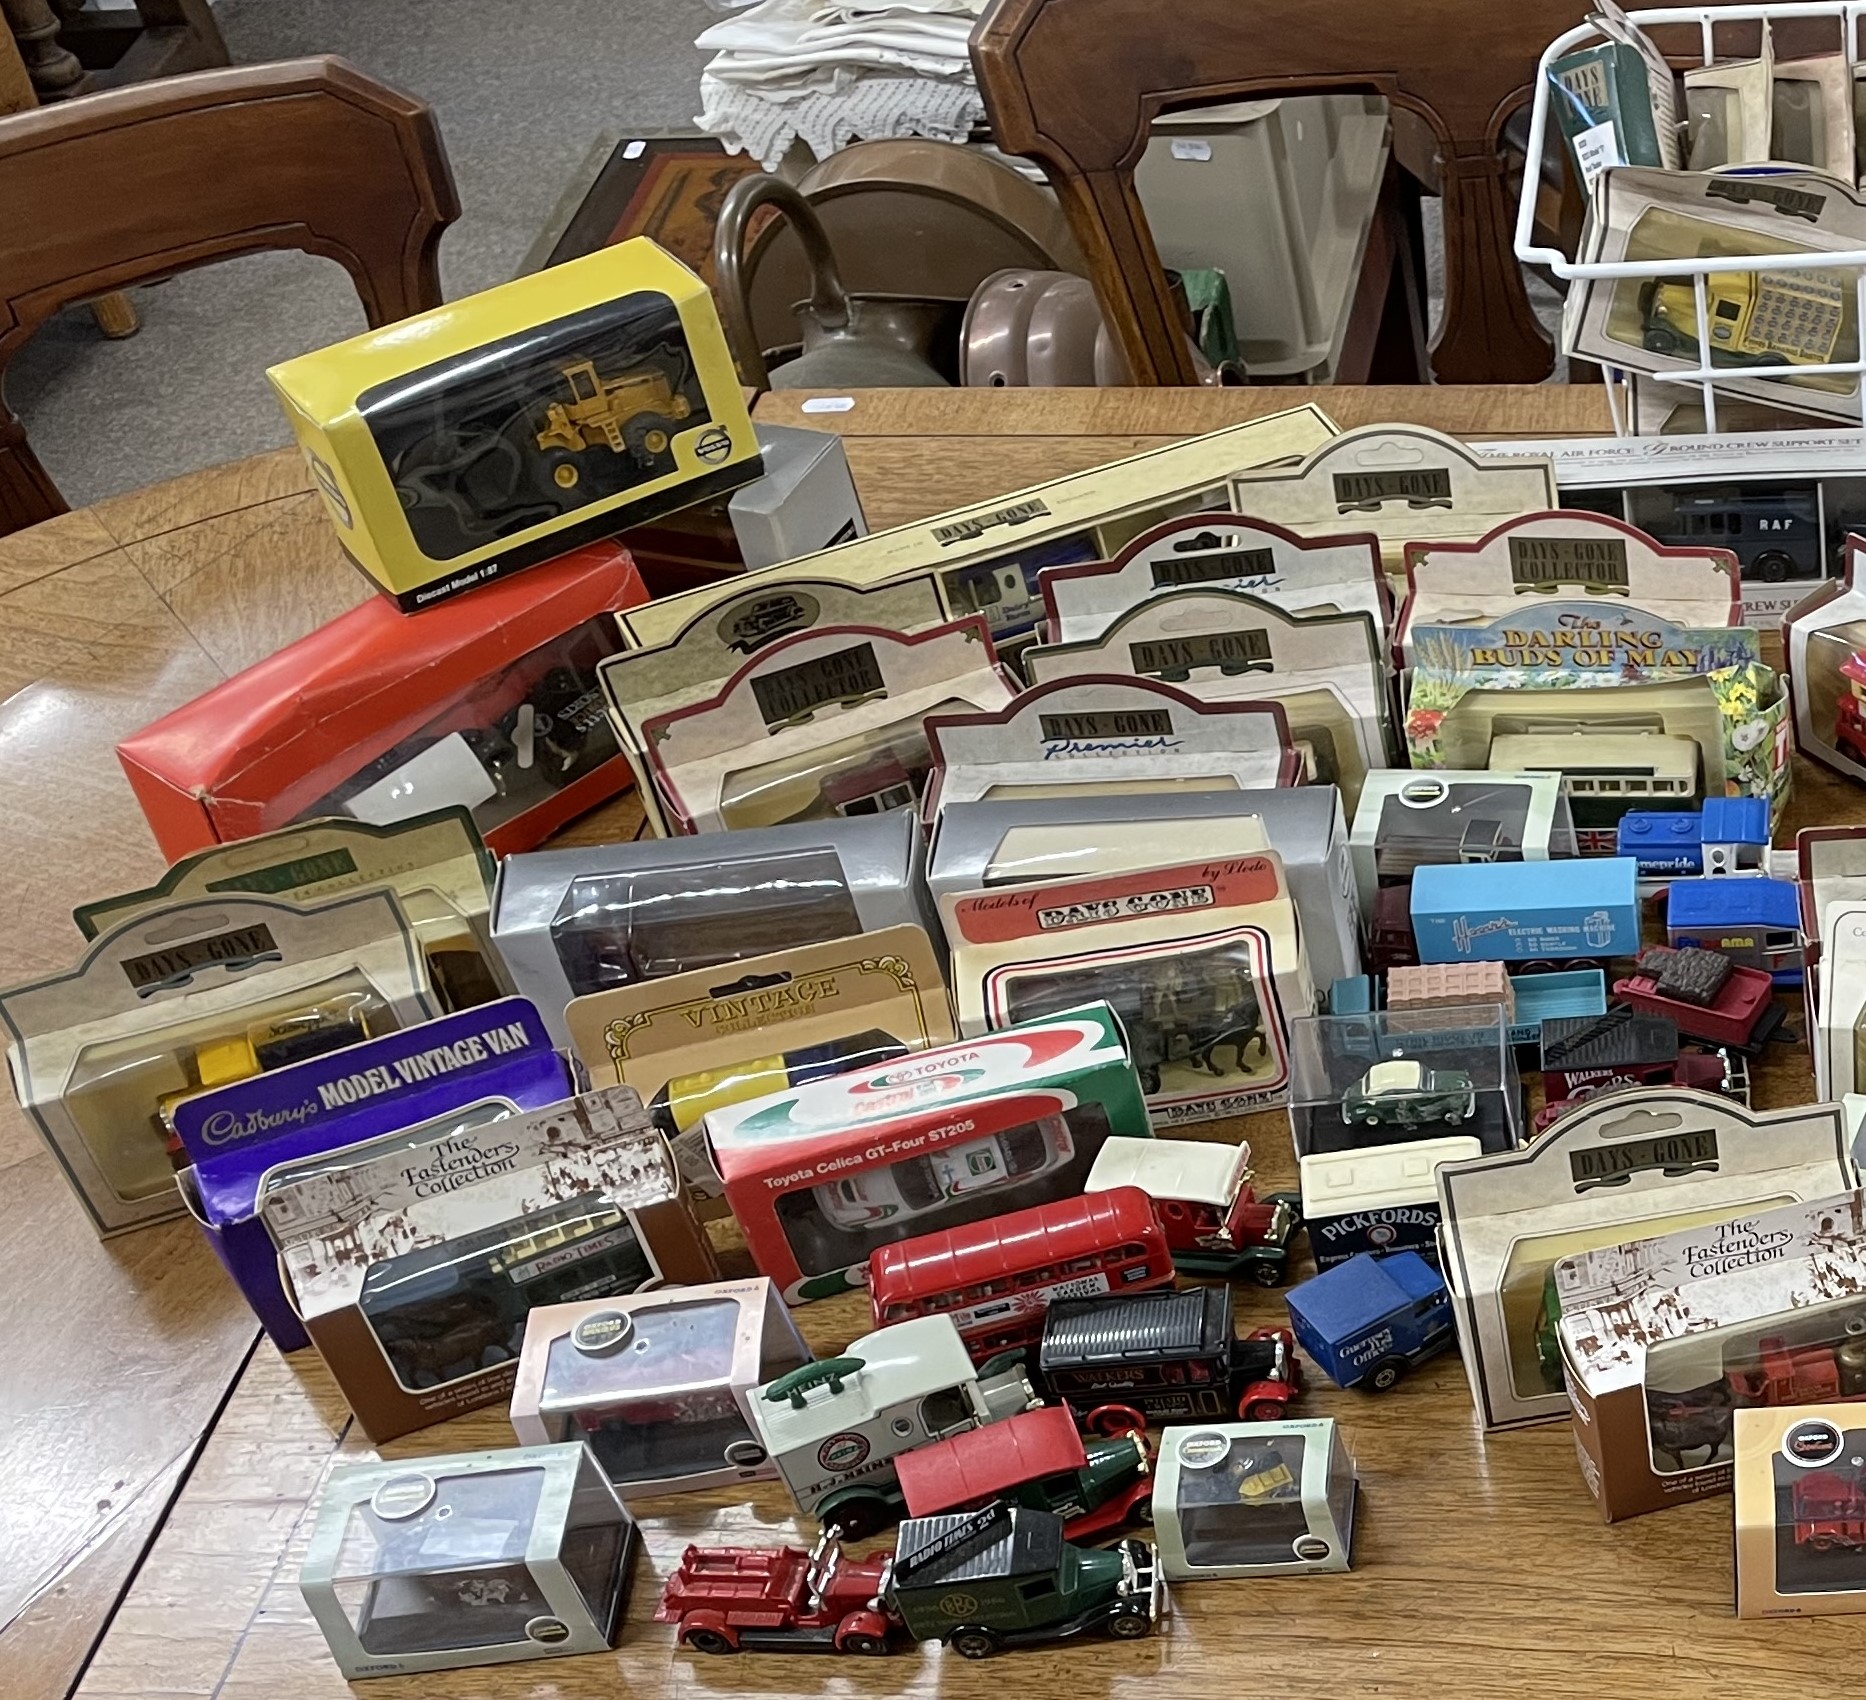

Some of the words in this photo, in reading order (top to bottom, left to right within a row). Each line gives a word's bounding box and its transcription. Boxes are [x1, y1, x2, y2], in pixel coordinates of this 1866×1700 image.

[1588, 446, 1634, 456] FORCE
[1725, 440, 1770, 451] CREW
[1759, 518, 1793, 531] RAF
[1503, 629, 1664, 650] DARLING
[1471, 647, 1564, 668] BUDS
[1571, 647, 1617, 667] OF
[1623, 648, 1701, 669] MAY
[1040, 737, 1184, 761] Premier
[1042, 898, 1120, 927] DAYS
[1126, 887, 1210, 913] GONE
[680, 974, 840, 1028] VINTAGE
[914, 1051, 981, 1077] TOYOTA
[201, 1101, 320, 1147] Cadbury's
[318, 1064, 402, 1110] MODEL
[396, 1036, 486, 1084] VINTAGE
[485, 1021, 531, 1060] VAN
[428, 1136, 478, 1160] The
[762, 1164, 815, 1191] Toyota
[816, 1153, 865, 1178] Celica
[865, 1133, 926, 1163] GT-Four
[927, 1117, 976, 1145] ST205
[1580, 1146, 1634, 1176] DAYS
[1651, 1135, 1711, 1165] GONE
[400, 1142, 521, 1188] Eastenders
[414, 1157, 517, 1198] Collection
[1321, 1208, 1439, 1242] PICKFORDS
[1713, 1218, 1761, 1241] The
[535, 1252, 572, 1273] RADIO
[1681, 1231, 1794, 1264] Eastenders
[1687, 1246, 1787, 1279] Collection
[786, 1372, 836, 1398] HEINZ
[908, 1540, 944, 1569] RADIO
[976, 1508, 996, 1531] 2d
